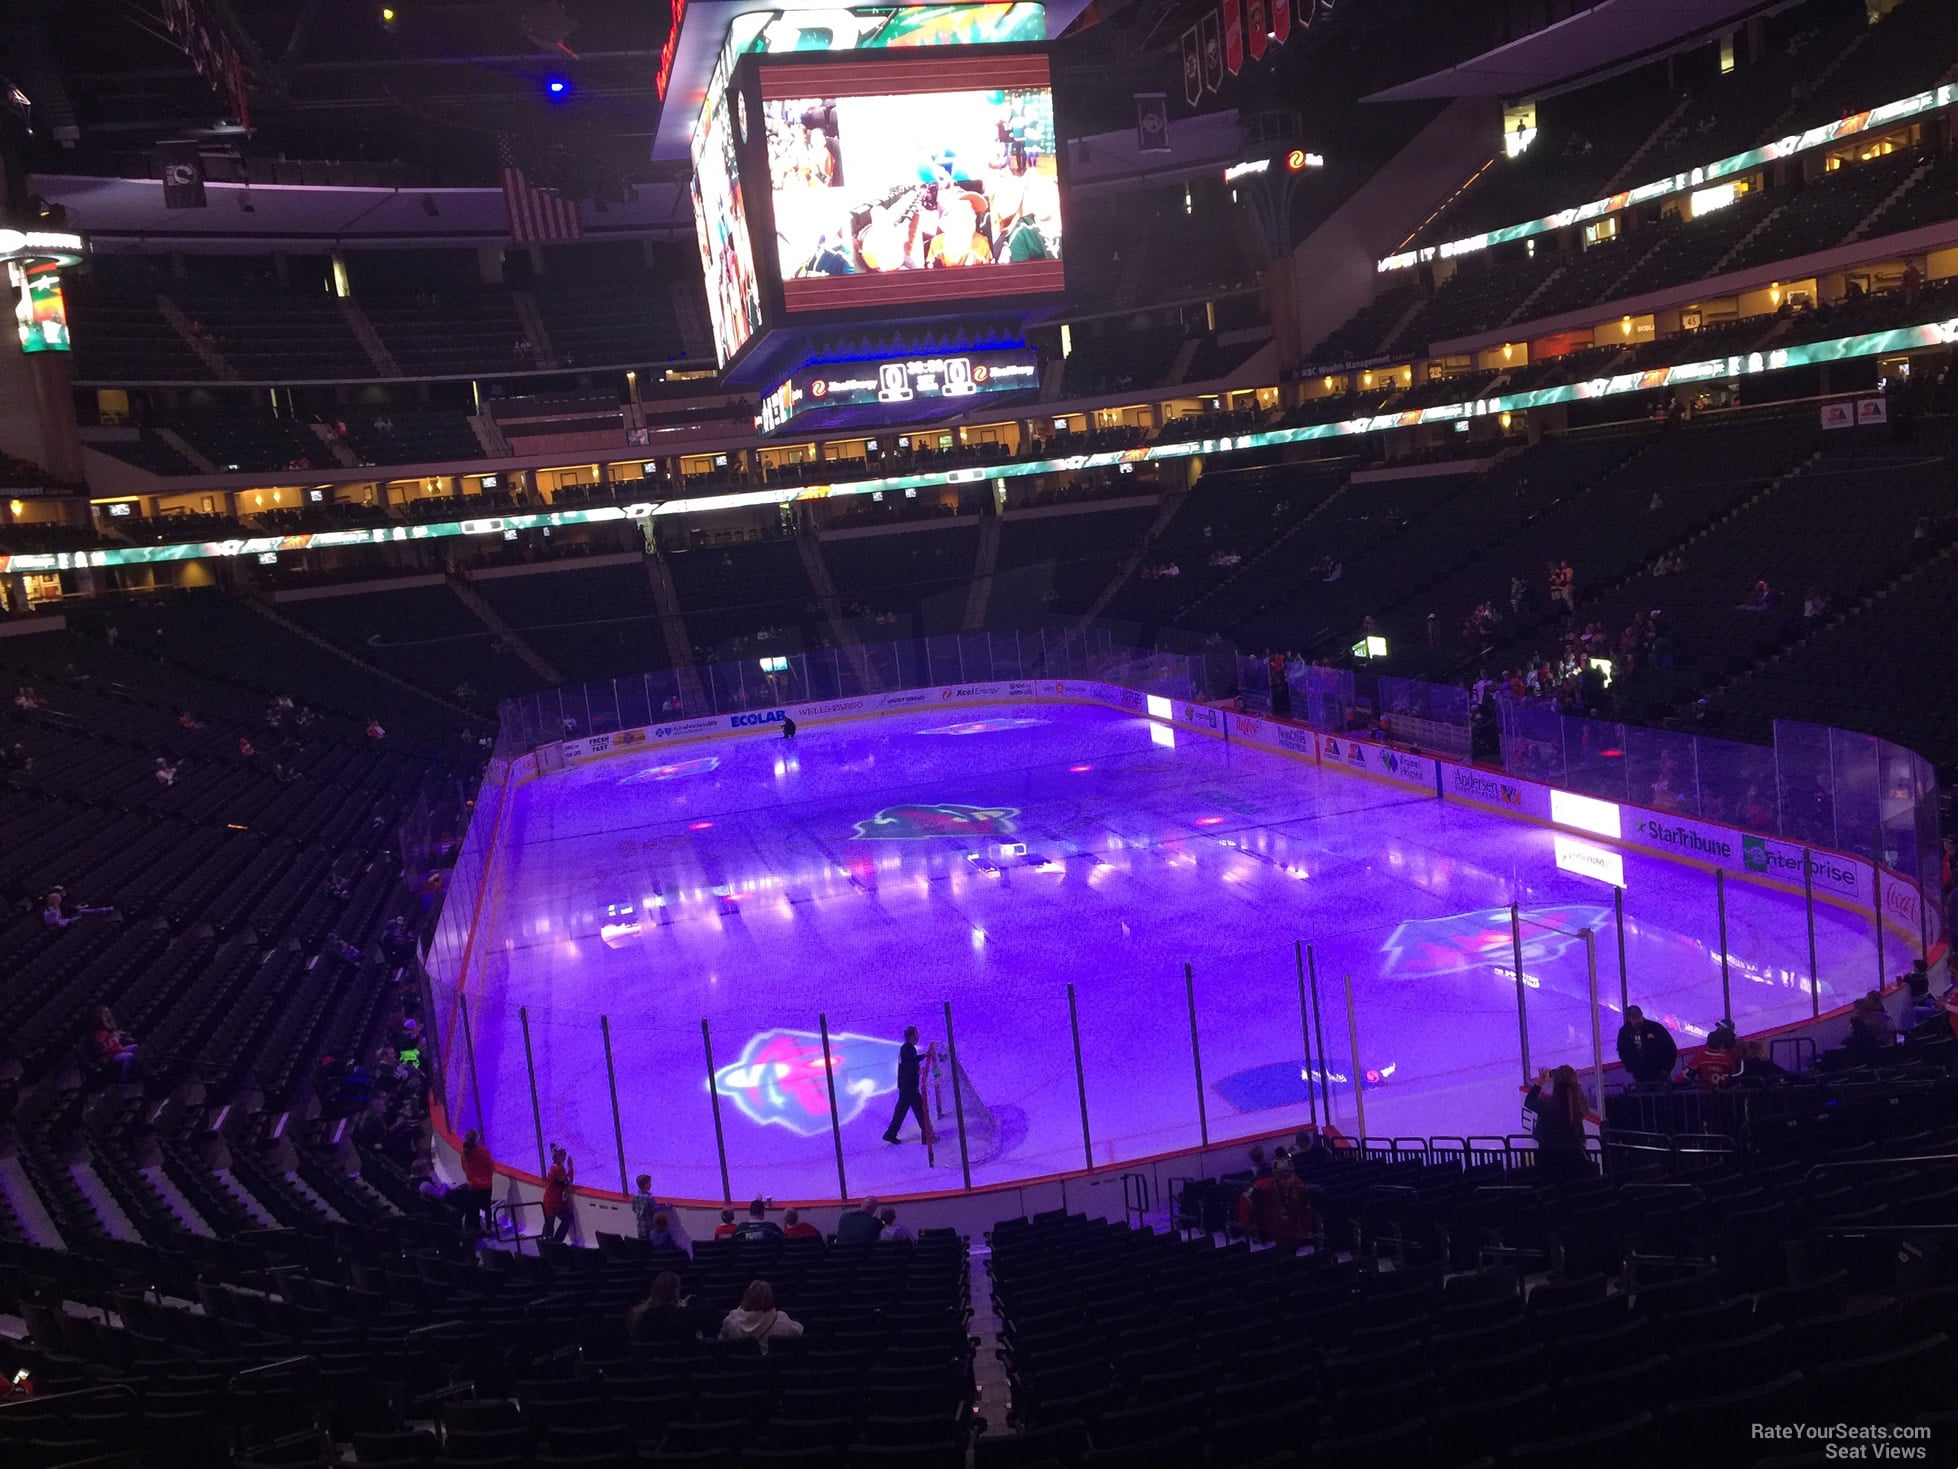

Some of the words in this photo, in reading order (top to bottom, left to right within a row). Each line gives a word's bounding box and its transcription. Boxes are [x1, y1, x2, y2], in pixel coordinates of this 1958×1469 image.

[1302, 367, 1317, 377] RBC
[1318, 362, 1345, 375] Wealth
[1345, 355, 1390, 369] Management
[730, 710, 785, 728] ECOLAB
[1454, 769, 1499, 793] Andersen
[1648, 821, 1731, 858] StarTribune
